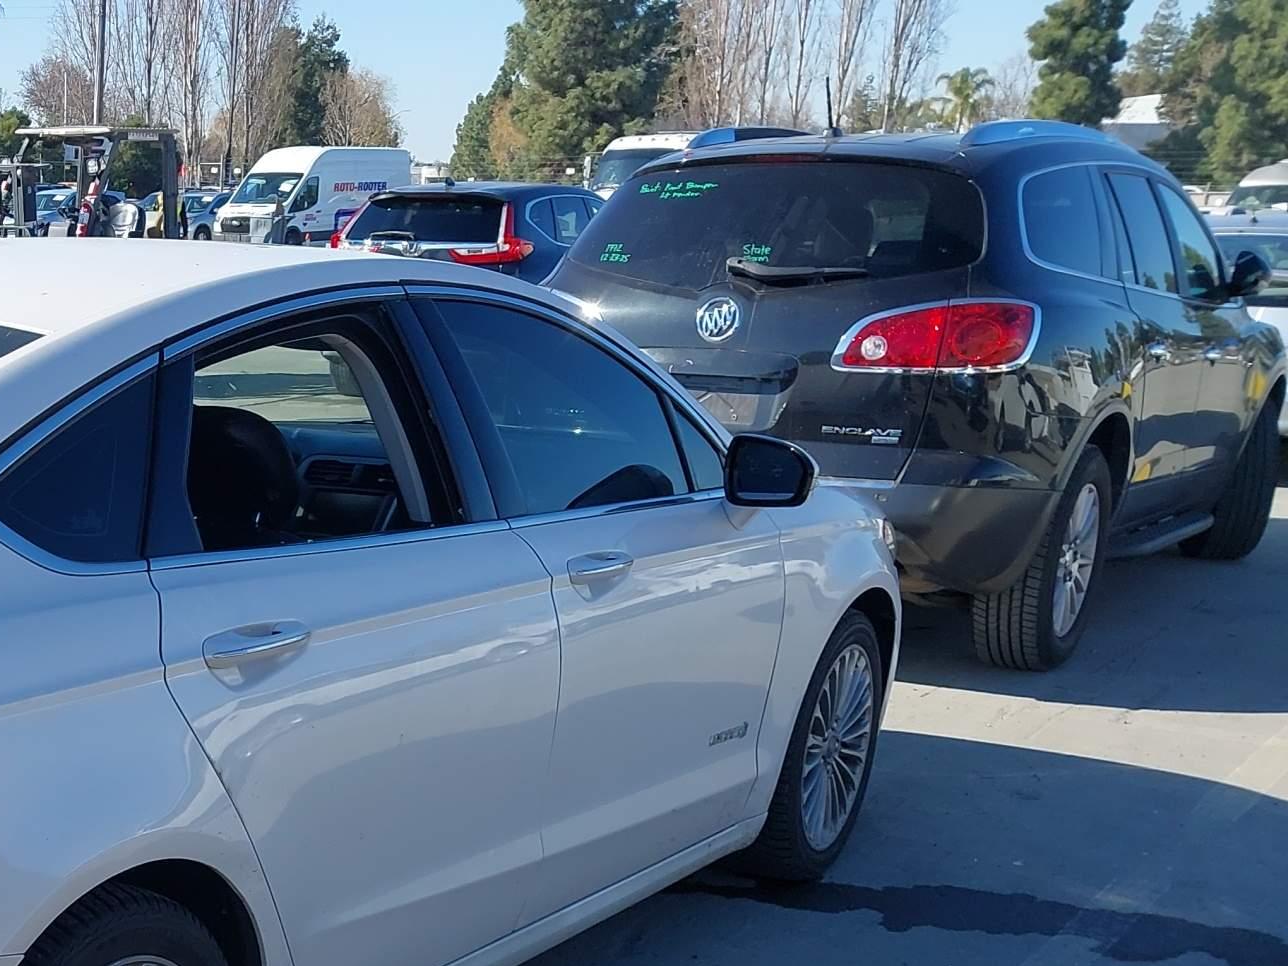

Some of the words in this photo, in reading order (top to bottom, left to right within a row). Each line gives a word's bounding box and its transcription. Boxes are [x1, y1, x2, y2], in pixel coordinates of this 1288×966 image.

[334, 181, 388, 192] ROTO-ROOTER
[743, 243, 772, 256] State
[821, 425, 902, 437] ENCLAVE
